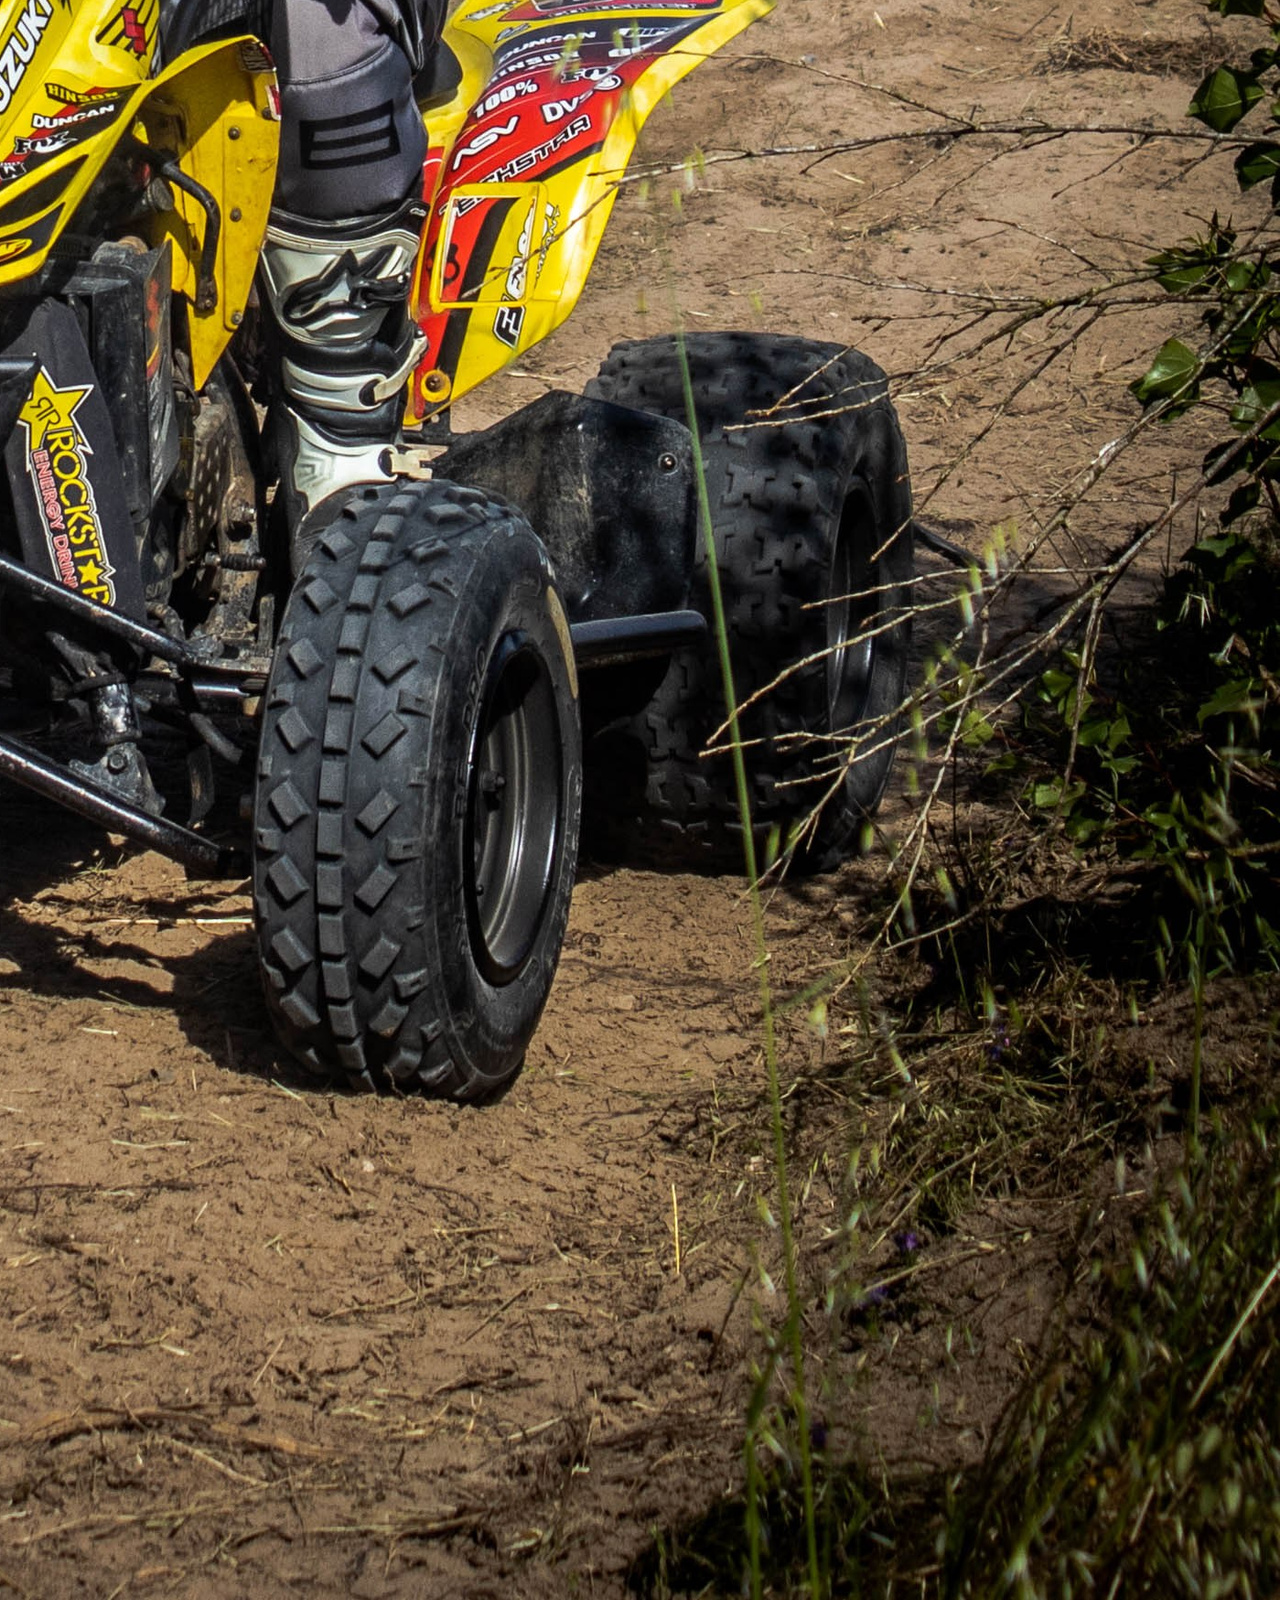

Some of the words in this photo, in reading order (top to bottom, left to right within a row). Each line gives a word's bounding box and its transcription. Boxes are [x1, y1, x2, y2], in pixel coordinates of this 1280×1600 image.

[498, 31, 597, 64] DUNCAN
[561, 65, 616, 84] FO
[45, 84, 119, 102] HINSON
[473, 79, 539, 119] 100%
[32, 104, 115, 129] DUNCAN
[14, 130, 76, 155] FOX
[32, 450, 65, 530] ENERGY
[52, 533, 78, 589] DRIN
